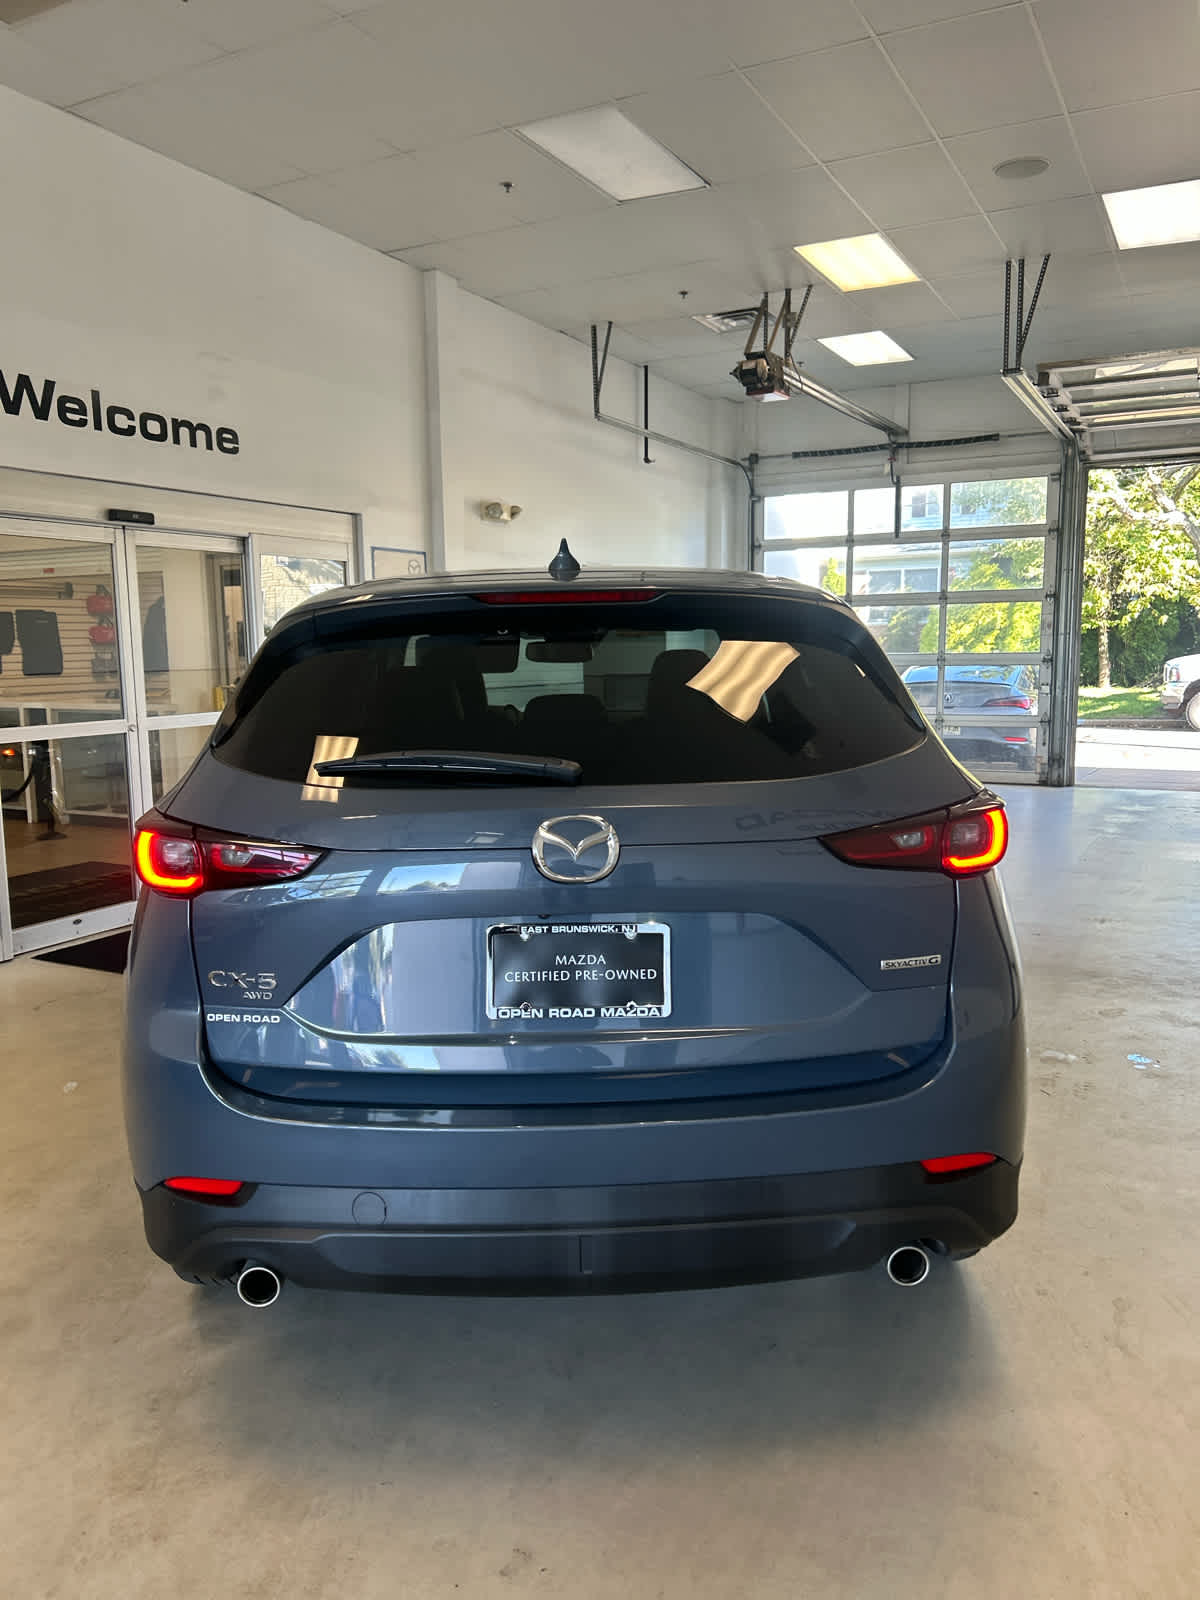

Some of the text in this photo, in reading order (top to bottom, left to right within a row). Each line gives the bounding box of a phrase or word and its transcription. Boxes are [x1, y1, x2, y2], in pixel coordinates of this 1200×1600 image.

[0, 369, 240, 455] Welcome
[520, 925, 549, 934] EAST
[621, 924, 637, 935] NJ
[555, 954, 607, 966] MAZDA
[207, 970, 278, 990] CX-5
[504, 968, 657, 983] CERTIFIED PRE-OWNED
[243, 991, 273, 1000] AWD
[206, 1013, 281, 1024] OPEN ROAD
[498, 1006, 662, 1019] OPEN ROAD MAZDA
